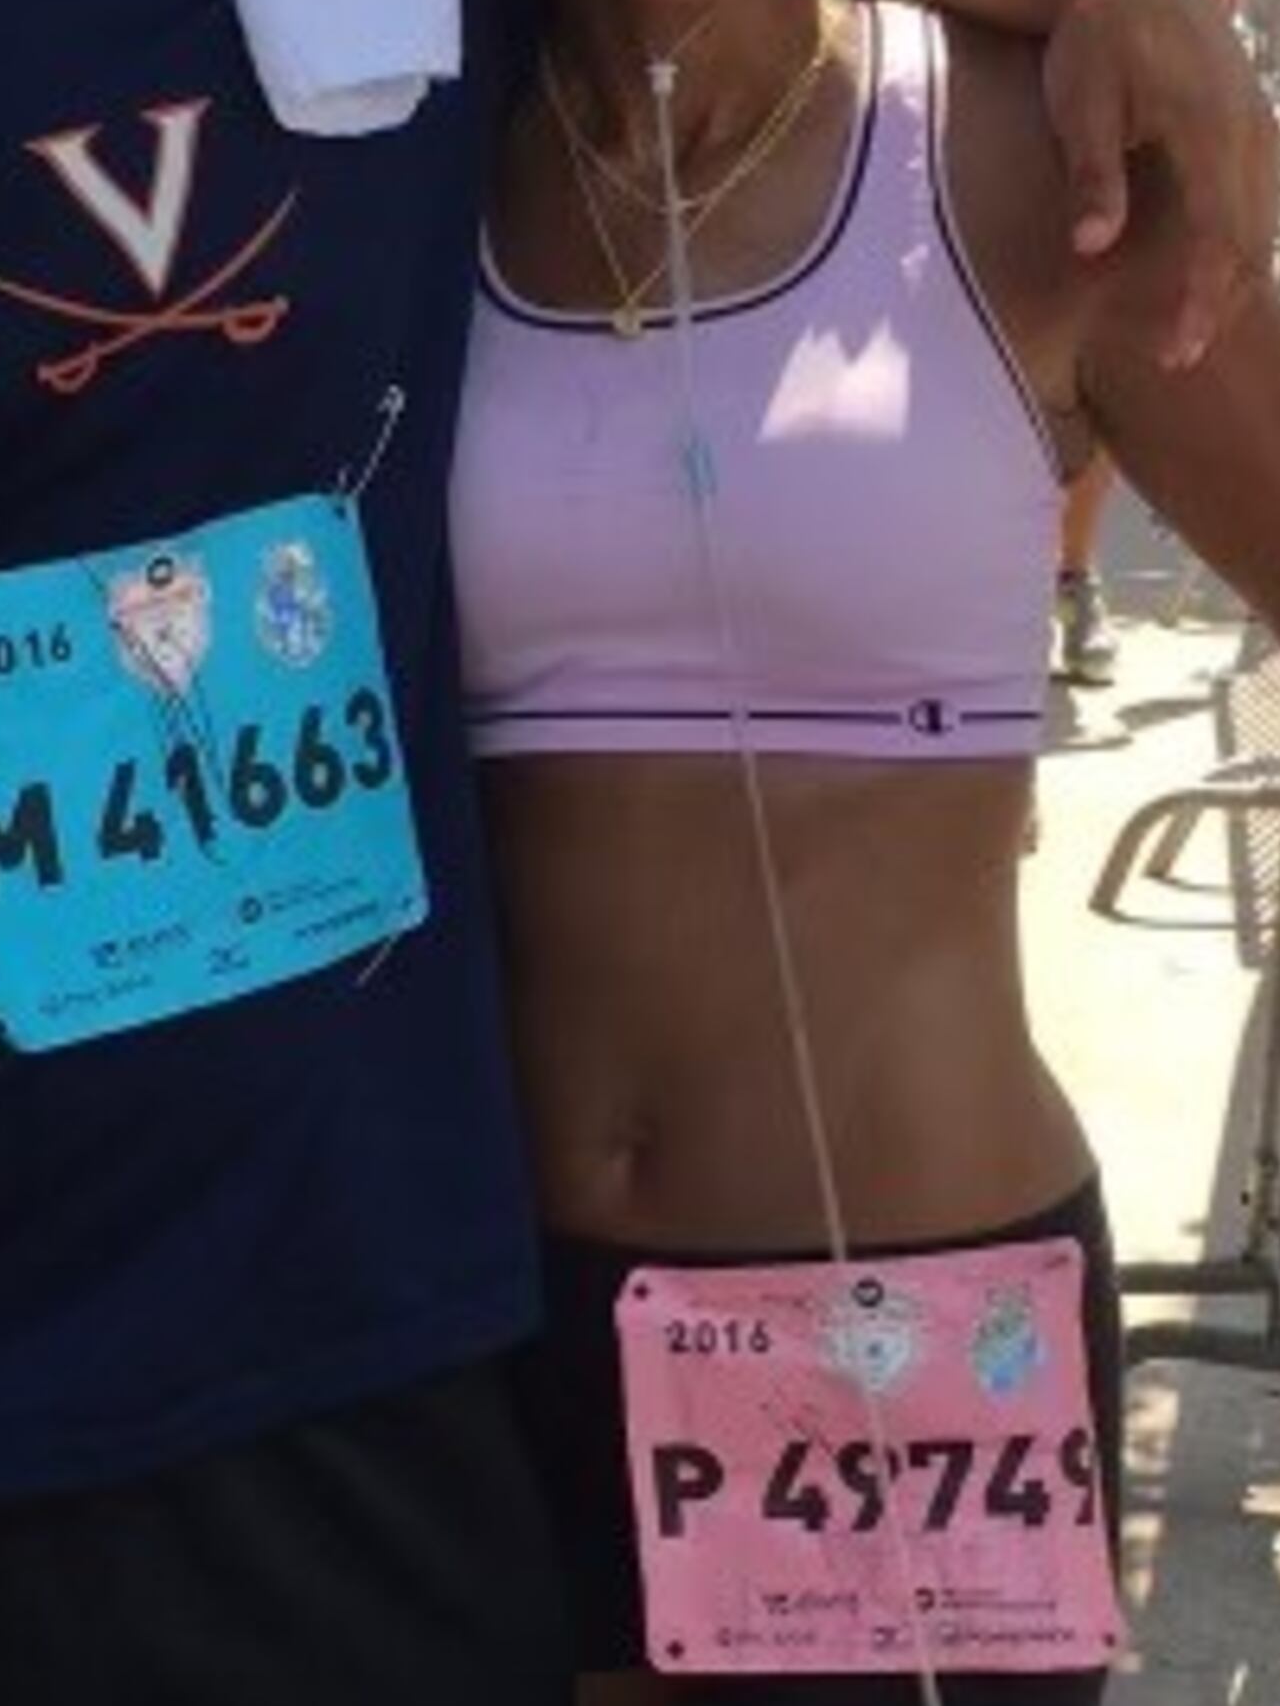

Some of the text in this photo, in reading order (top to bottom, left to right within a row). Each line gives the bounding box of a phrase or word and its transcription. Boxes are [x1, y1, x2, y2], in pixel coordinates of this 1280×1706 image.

[25, 97, 211, 298] V
[99, 687, 393, 861] 41663
[664, 1319, 772, 1355] 2016
[651, 1429, 1095, 1539] P 49749
